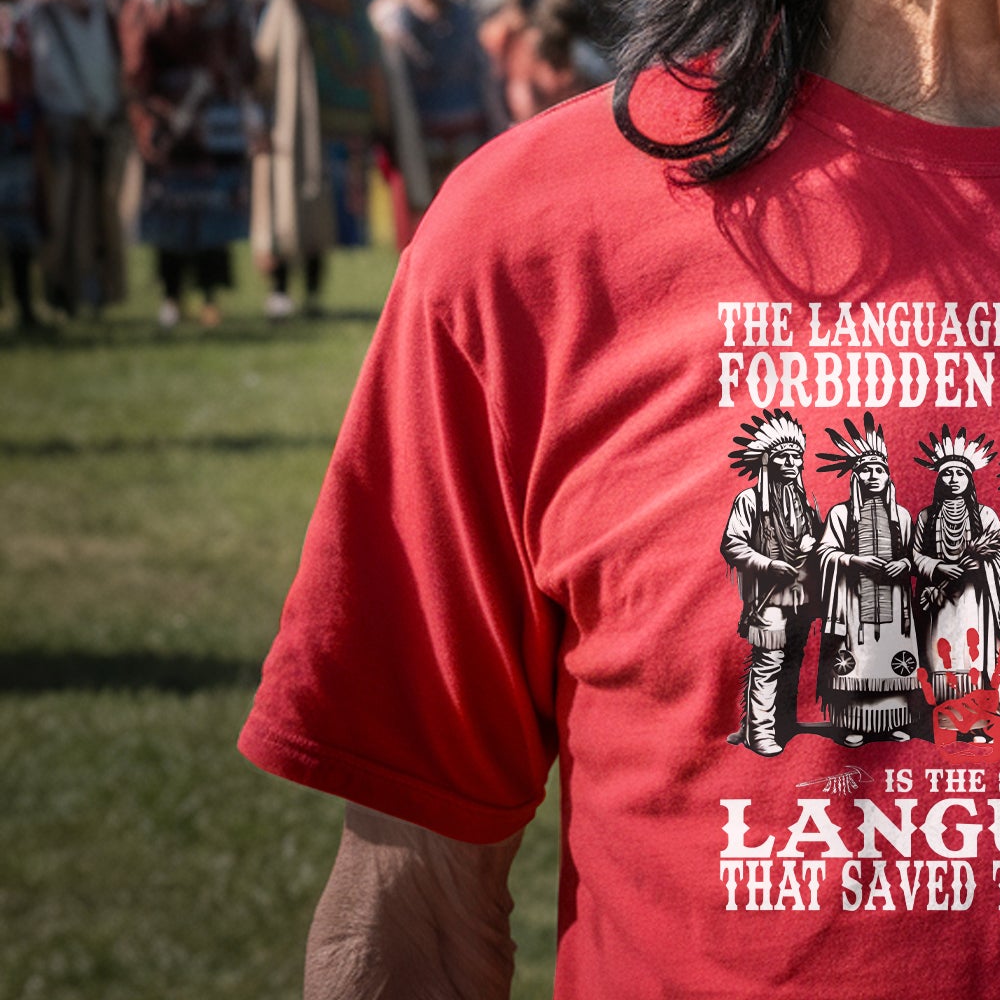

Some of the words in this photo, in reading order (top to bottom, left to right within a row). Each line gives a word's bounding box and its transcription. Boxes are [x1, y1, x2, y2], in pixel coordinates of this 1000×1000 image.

[718, 302, 793, 347] THE
[718, 352, 996, 408] FORBIDDEN
[884, 768, 914, 793] IS
[924, 768, 985, 793] THE
[719, 860, 827, 911] THAT
[841, 860, 977, 911] SAVED
